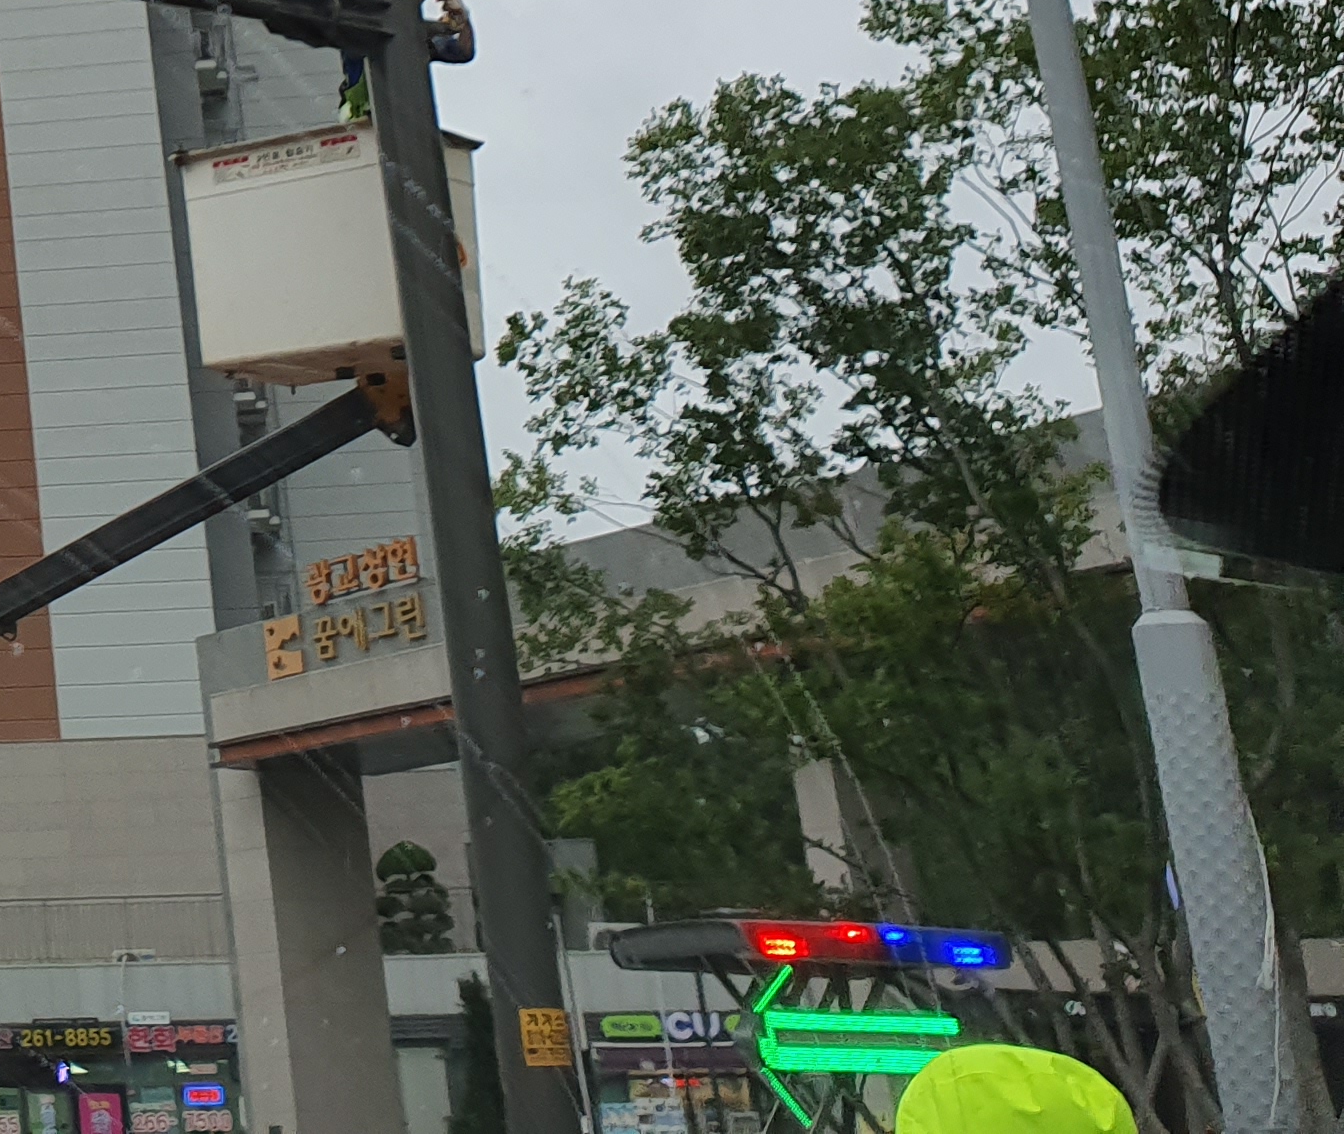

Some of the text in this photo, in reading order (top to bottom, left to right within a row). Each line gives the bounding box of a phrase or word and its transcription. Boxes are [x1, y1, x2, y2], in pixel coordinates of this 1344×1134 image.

[305, 535, 419, 606] 광교상현
[313, 591, 427, 661] 꿈에그린
[20, 1027, 112, 1048] 261-8855
[667, 1011, 720, 1041] CU
